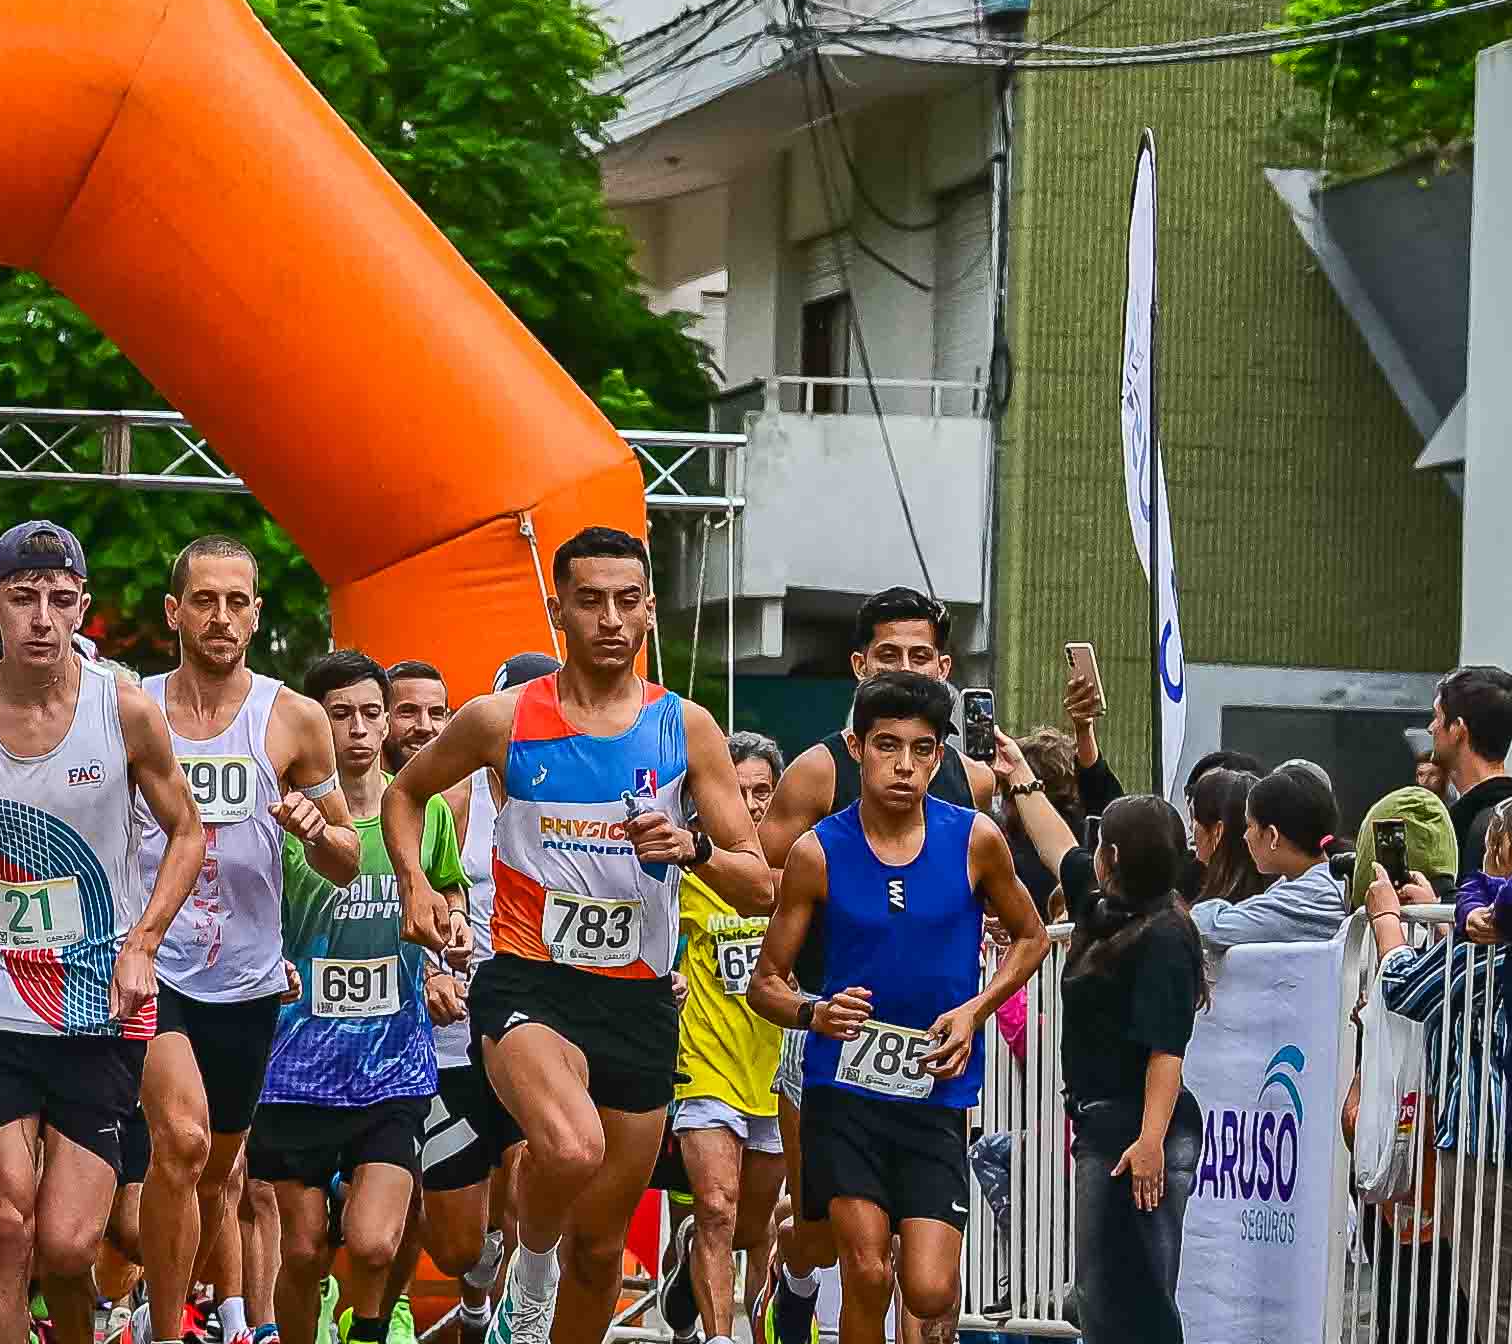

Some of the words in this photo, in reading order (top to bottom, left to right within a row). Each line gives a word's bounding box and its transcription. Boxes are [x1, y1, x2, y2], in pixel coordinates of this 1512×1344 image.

[67, 765, 101, 783] FAC
[542, 840, 634, 856] RUNNER
[4, 888, 54, 933] 21
[333, 901, 403, 920] corr
[552, 898, 633, 948] 783
[322, 964, 390, 1003] 691
[849, 1026, 933, 1081] 785
[1188, 1109, 1298, 1203] ARUSO
[1240, 1208, 1296, 1245] SEGUROS
